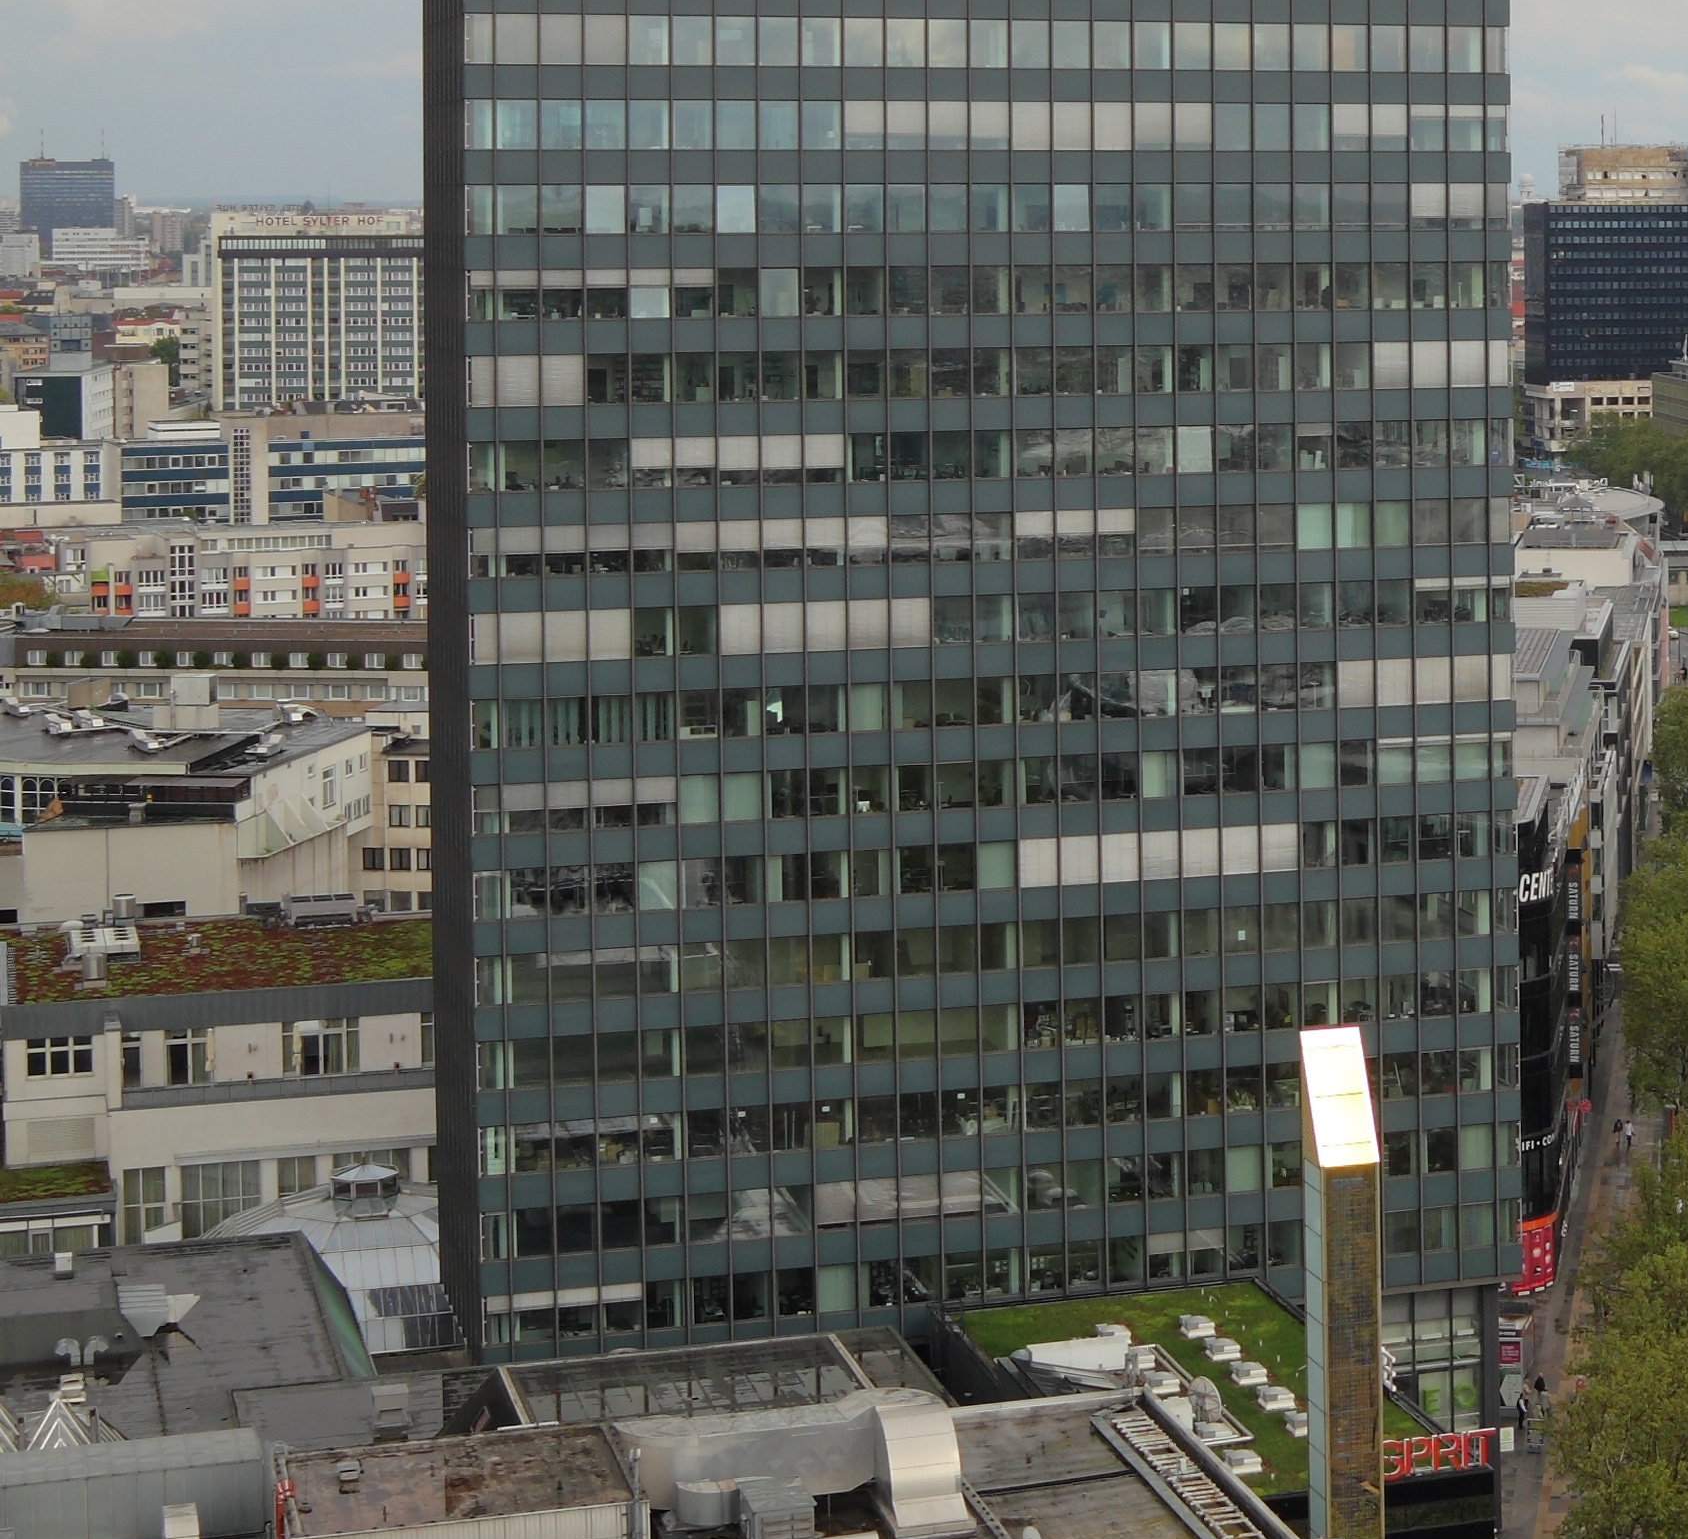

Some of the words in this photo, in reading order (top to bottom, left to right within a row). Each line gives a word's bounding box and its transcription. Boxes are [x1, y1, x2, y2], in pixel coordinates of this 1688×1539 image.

[256, 217, 297, 226] HOTEL
[302, 216, 349, 226] SYLTER
[357, 216, 383, 225] HOF
[1568, 882, 1579, 920] SATURN
[1569, 954, 1580, 992] SATURN
[1569, 1025, 1580, 1062] SATURN
[1383, 1427, 1497, 1481] SPRIT
